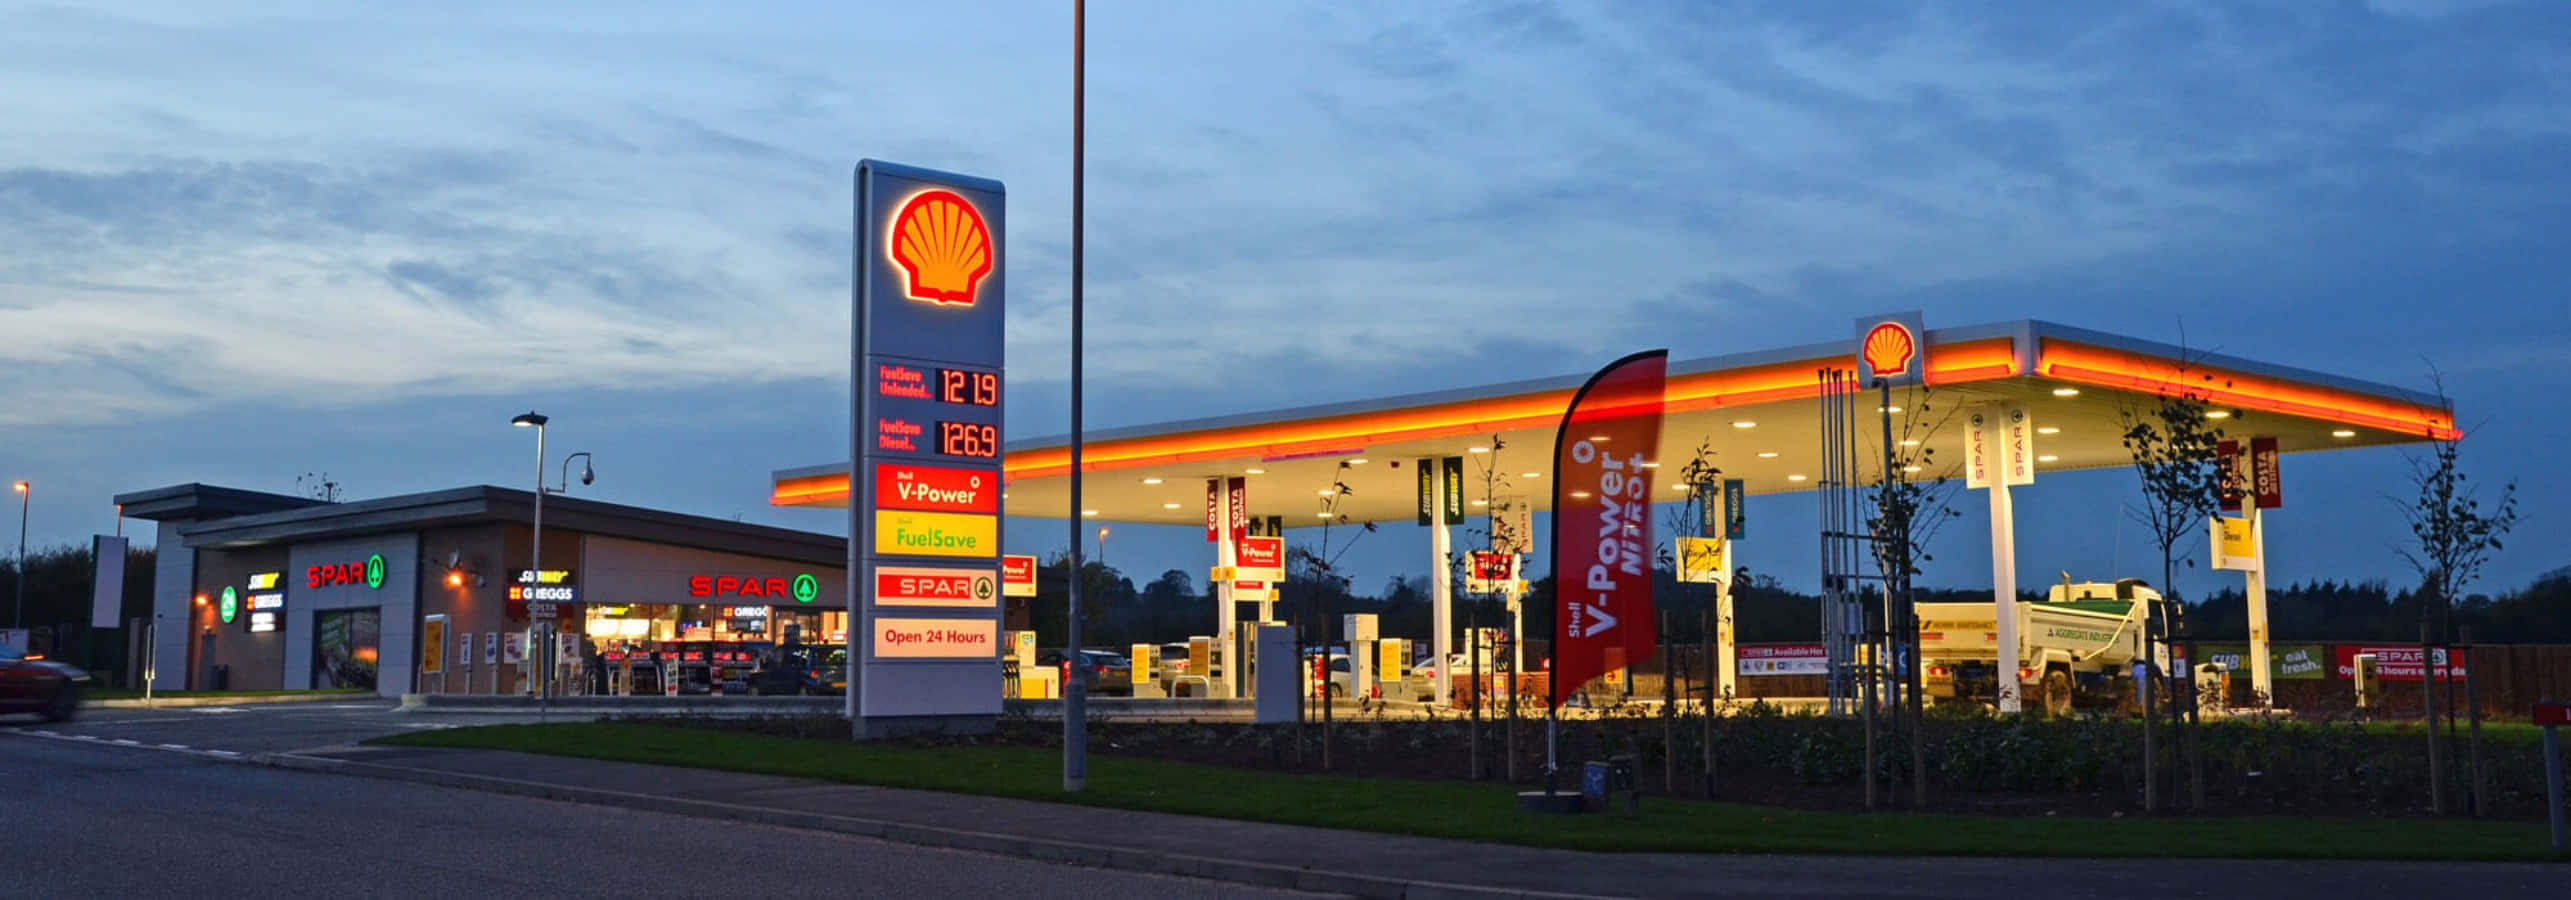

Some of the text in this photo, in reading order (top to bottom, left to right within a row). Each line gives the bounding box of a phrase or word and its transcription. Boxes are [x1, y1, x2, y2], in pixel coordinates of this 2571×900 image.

[943, 370, 997, 405] 121.9
[943, 422, 997, 458] 126.9
[1974, 430, 1984, 480] SPAR
[2014, 426, 2025, 477] SPAR
[2257, 451, 2269, 496] COSTA
[897, 482, 977, 505] V-Power
[1232, 489, 1240, 528] COSTA
[1208, 493, 1216, 531] COSTA
[896, 527, 977, 549] FuelSave
[1585, 451, 1625, 638] V-Power
[307, 561, 365, 589] SPAR
[690, 576, 786, 597] SPAR
[900, 578, 969, 596] SPAR
[885, 629, 986, 646] Open 24 Hours
[1568, 602, 1581, 638] Shell
